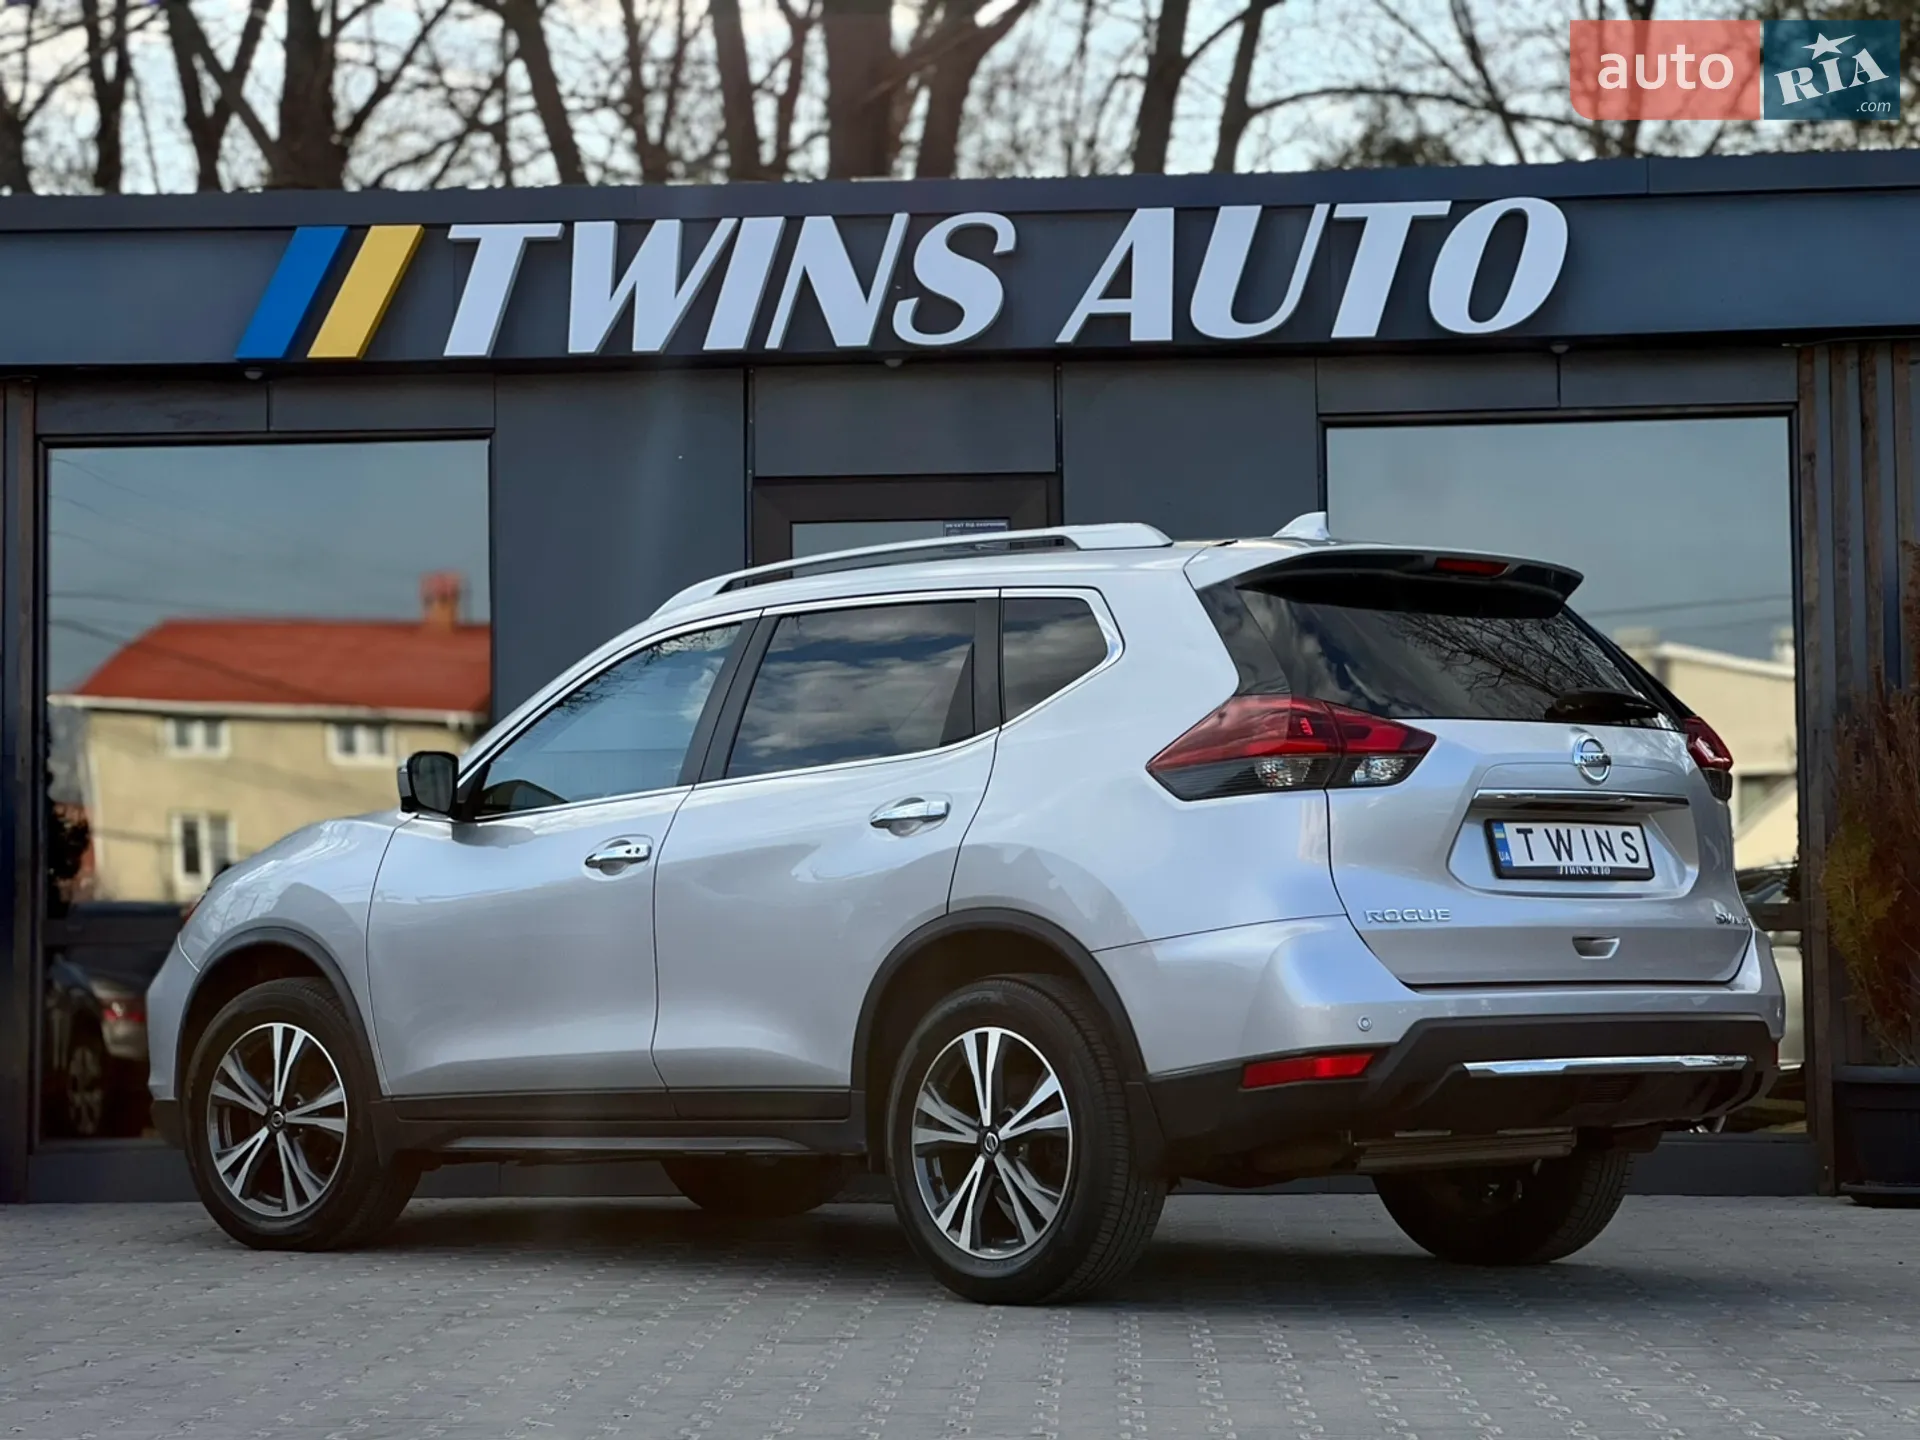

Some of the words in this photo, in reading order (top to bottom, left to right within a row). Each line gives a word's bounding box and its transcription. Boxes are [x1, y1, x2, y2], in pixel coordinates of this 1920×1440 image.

[442, 211, 1017, 357] TWINS
[1054, 196, 1570, 344] AUTO
[1498, 851, 1511, 862] UA
[1515, 827, 1640, 864] TWINS
[1364, 908, 1452, 923] ROGUE
